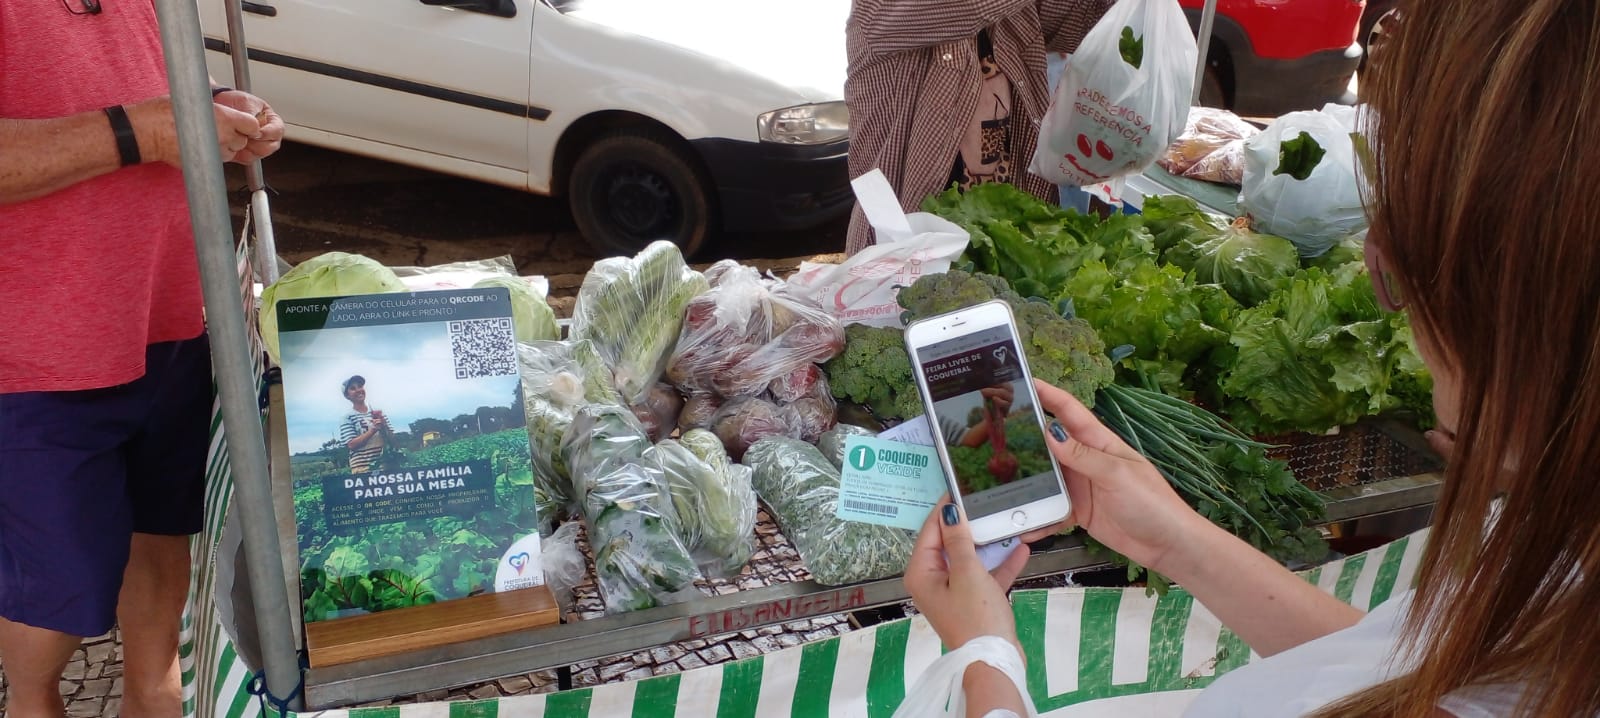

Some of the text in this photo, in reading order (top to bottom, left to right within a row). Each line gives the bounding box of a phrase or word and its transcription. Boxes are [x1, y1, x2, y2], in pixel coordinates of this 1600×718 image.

[285, 294, 498, 314] APONTE A CÂMERA DO CELULAR PARA O QRCODE AO
[360, 312, 381, 320] ABRA
[382, 311, 390, 319] O
[392, 310, 410, 318] LINK
[412, 309, 417, 317] E
[419, 307, 453, 317] PRONTO
[926, 353, 982, 374] FEIRA LIVRE DE
[928, 365, 972, 382] COQUEIRAL
[858, 447, 928, 469] 1 COQUEIRO
[344, 465, 472, 489] DA NOSSA FAMÍLIA
[877, 462, 922, 479] VERDE
[354, 477, 465, 499] PARA SUA MESA
